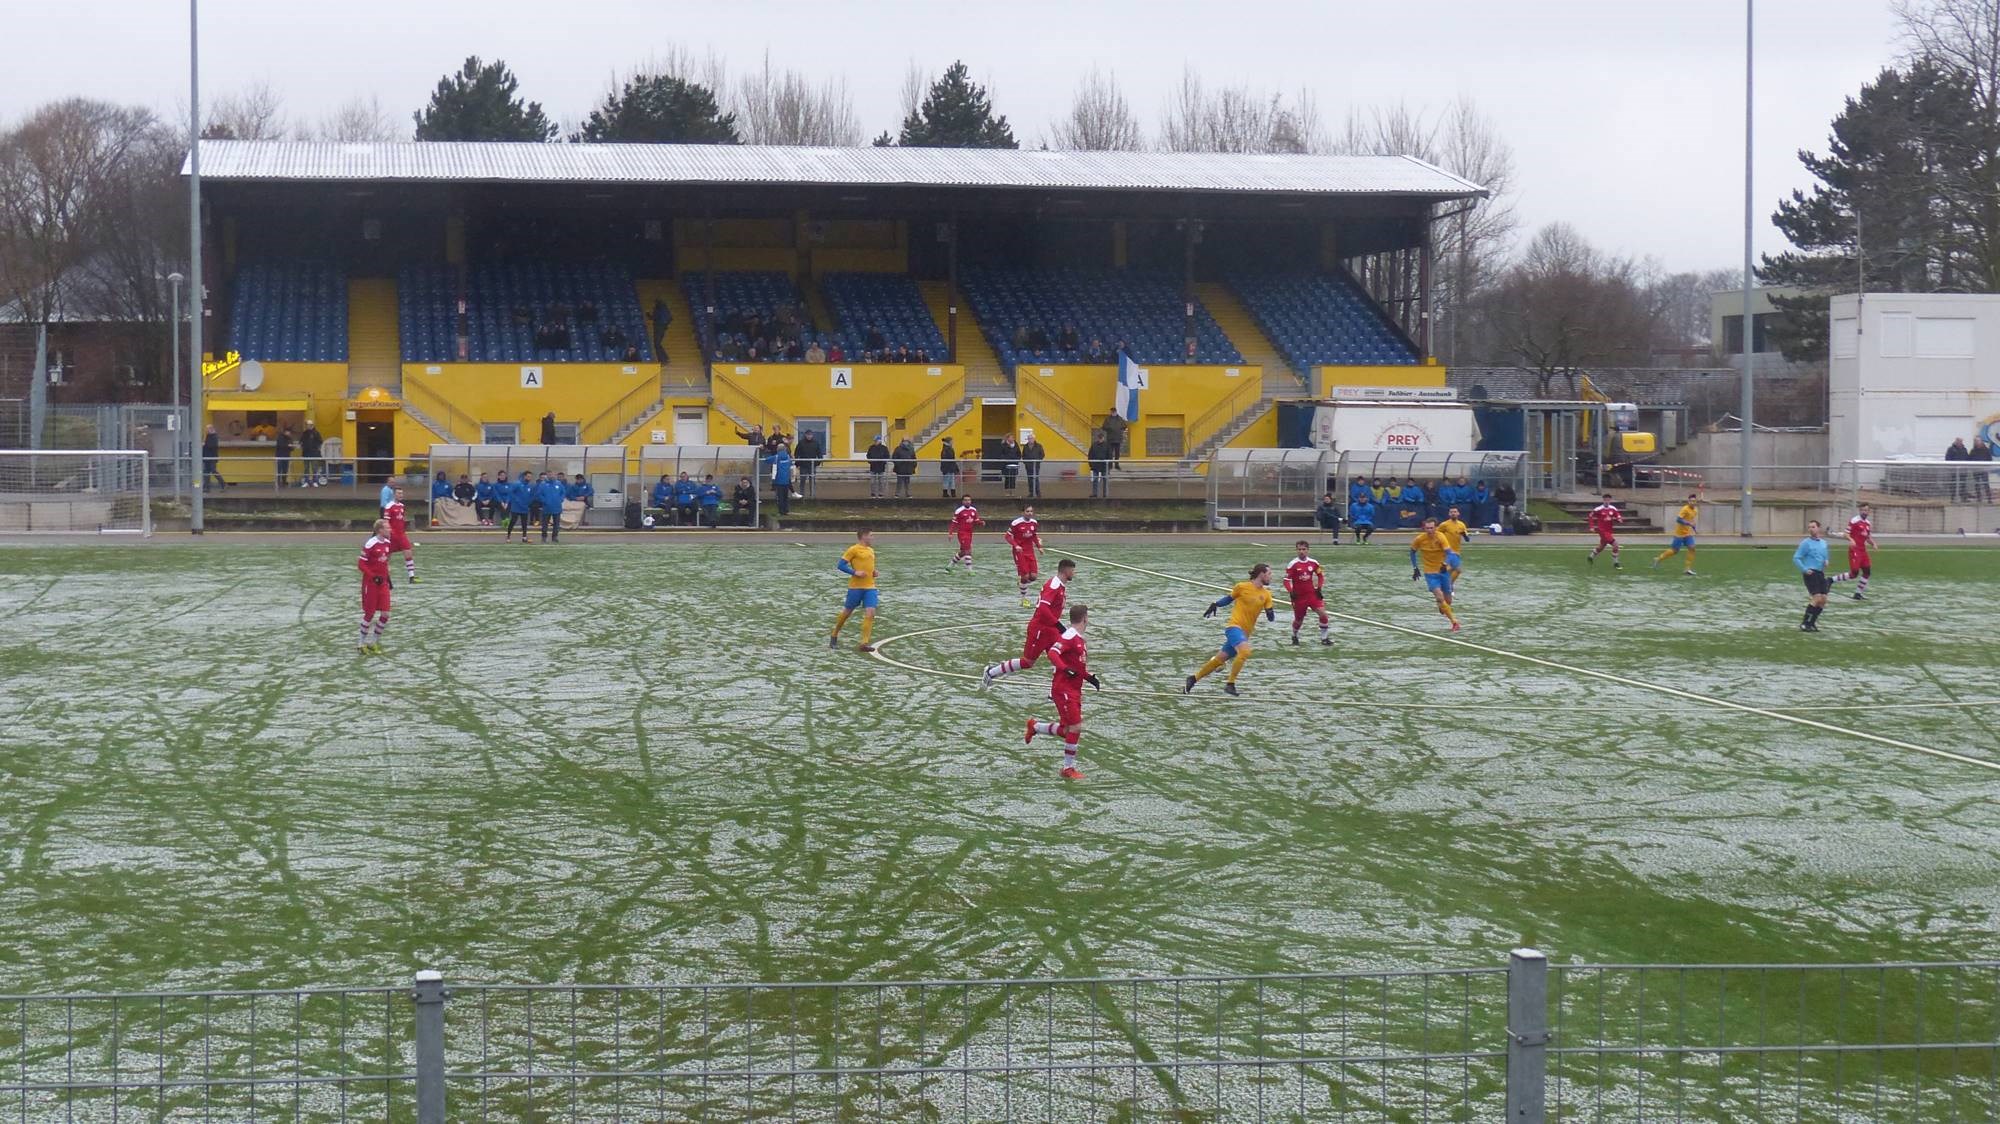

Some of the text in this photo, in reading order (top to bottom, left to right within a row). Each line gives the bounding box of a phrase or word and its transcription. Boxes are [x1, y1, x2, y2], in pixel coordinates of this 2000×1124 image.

[525, 372, 538, 385] A
[835, 373, 848, 386] A
[1387, 434, 1420, 445] PREY
